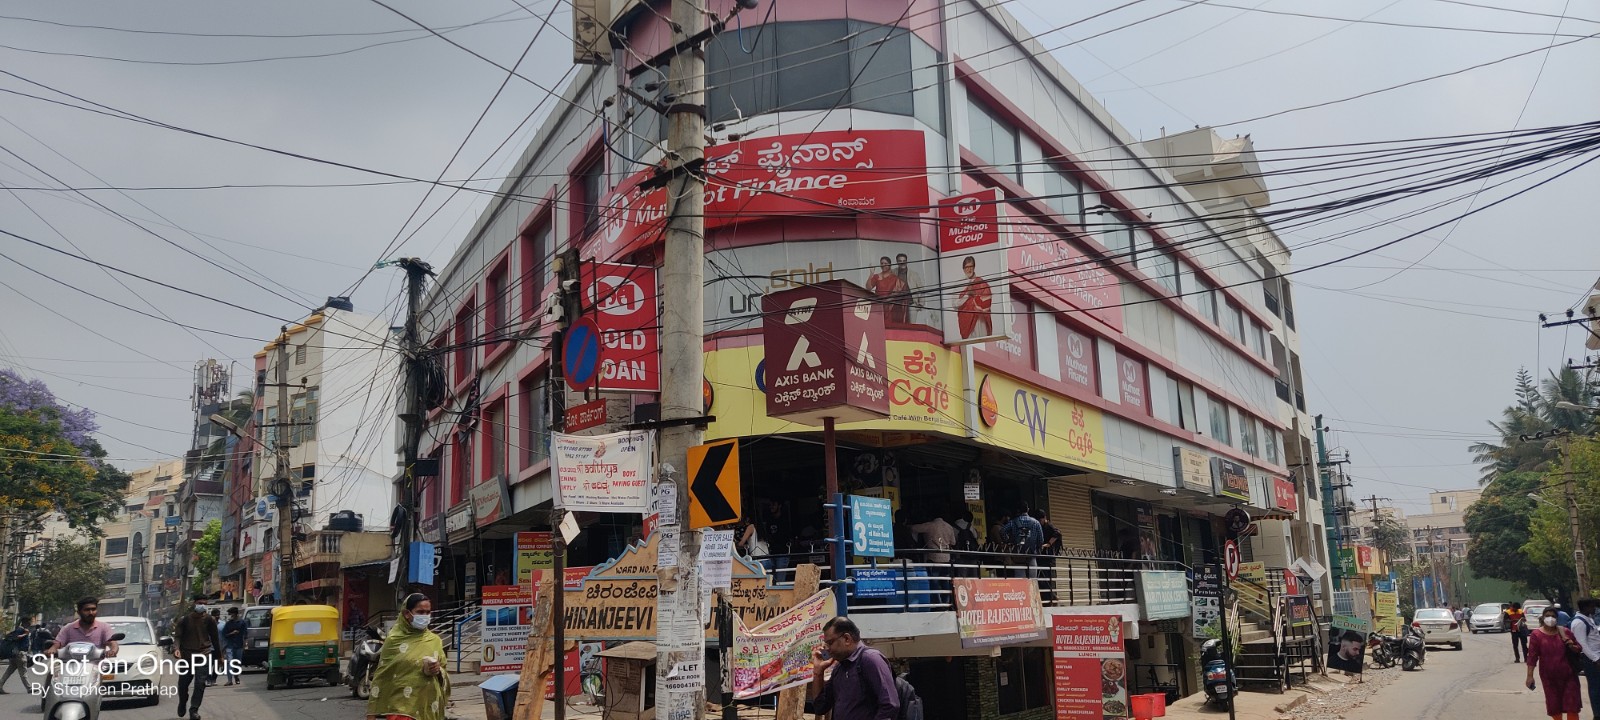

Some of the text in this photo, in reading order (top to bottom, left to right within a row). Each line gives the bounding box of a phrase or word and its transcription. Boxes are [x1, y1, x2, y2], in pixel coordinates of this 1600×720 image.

[733, 172, 848, 199] Finance
[949, 222, 989, 237] Muthoot
[954, 232, 984, 244] Group
[1068, 278, 1103, 309] Finance
[602, 328, 646, 350] OLD
[603, 359, 646, 381] OAN
[903, 349, 938, 380] ಕೆಫೆ
[1065, 355, 1088, 374] Muthoot
[774, 368, 835, 388] AXIS BANK
[850, 365, 883, 385] AXIS BANK
[1068, 368, 1088, 386] Finance
[888, 377, 949, 414] Café
[1122, 381, 1140, 396] Muthoot
[1124, 391, 1141, 407] Finance
[1068, 429, 1093, 458] Café
[584, 459, 618, 478] adithya
[612, 480, 631, 488] PAYING
[704, 533, 733, 542] SITE FOR SALE
[855, 522, 867, 552] 3
[639, 566, 651, 575] NO.
[563, 606, 654, 631] HIRANJEEVI
[960, 606, 1033, 625] HOTEL RAJESHWARI
[1333, 621, 1368, 631] ICONIC
[764, 638, 792, 653] FARM
[795, 623, 821, 641] FRESH
[1055, 634, 1111, 645] HOTEL RAJESHWARI
